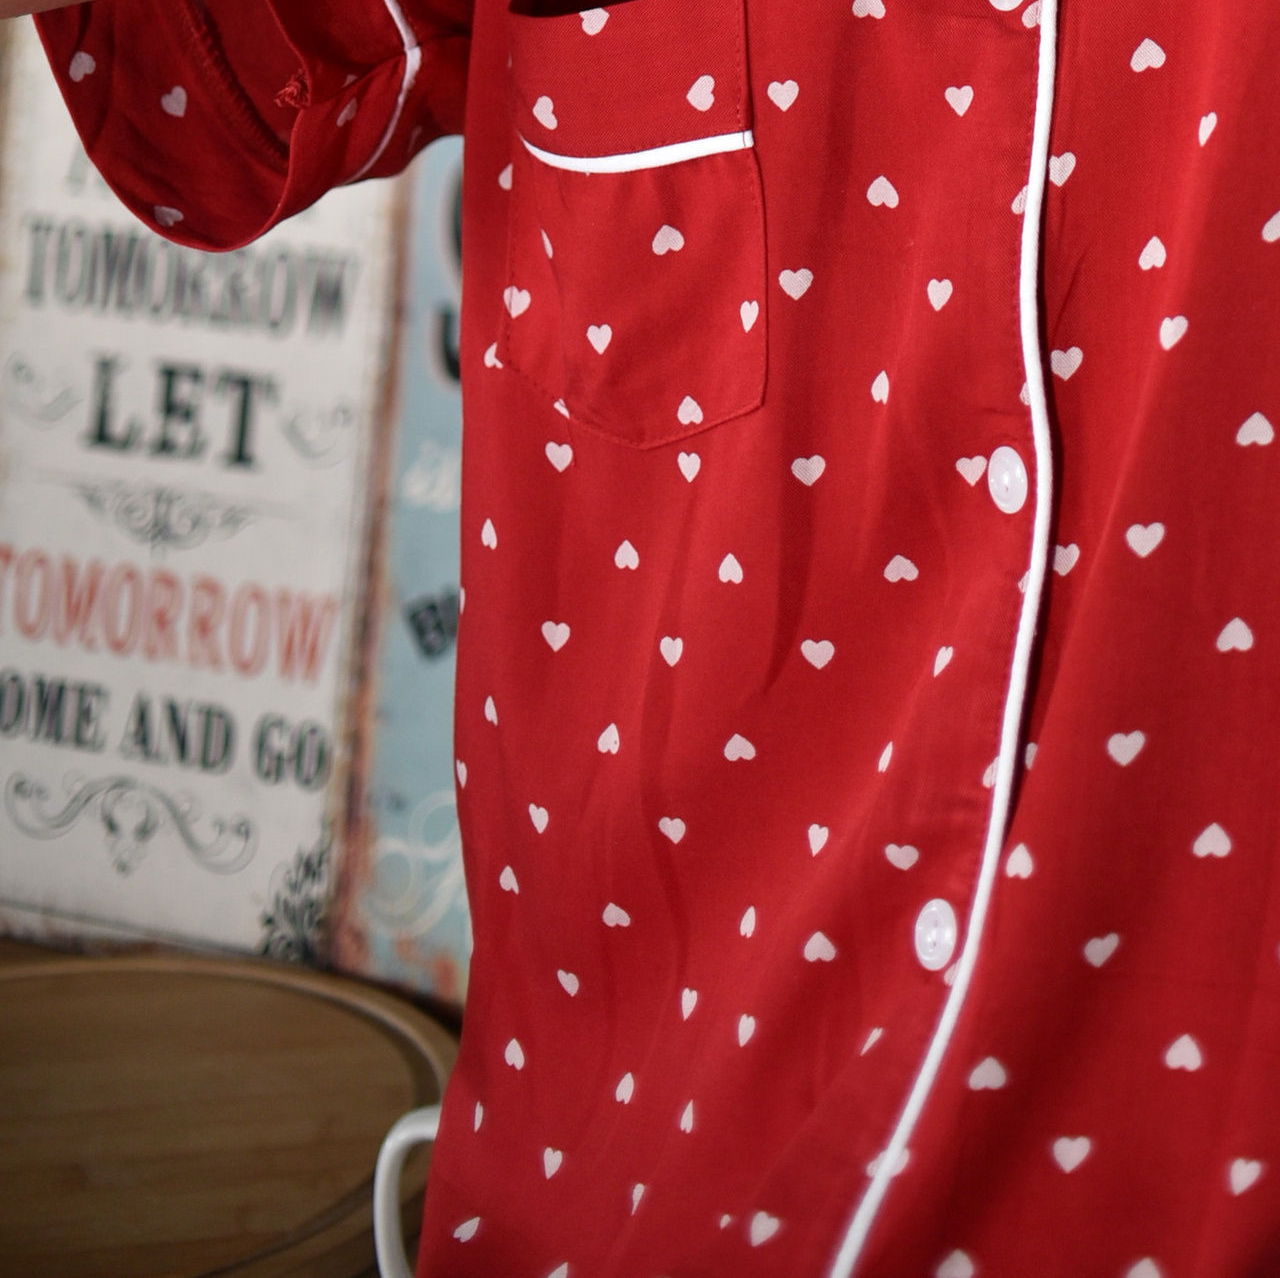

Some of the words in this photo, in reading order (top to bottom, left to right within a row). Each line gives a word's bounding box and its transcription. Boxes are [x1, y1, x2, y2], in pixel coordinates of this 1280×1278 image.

[24, 212, 362, 340] TOMORROW
[84, 350, 280, 472] LET
[118, 686, 238, 776] AND
[252, 710, 332, 794] GO
